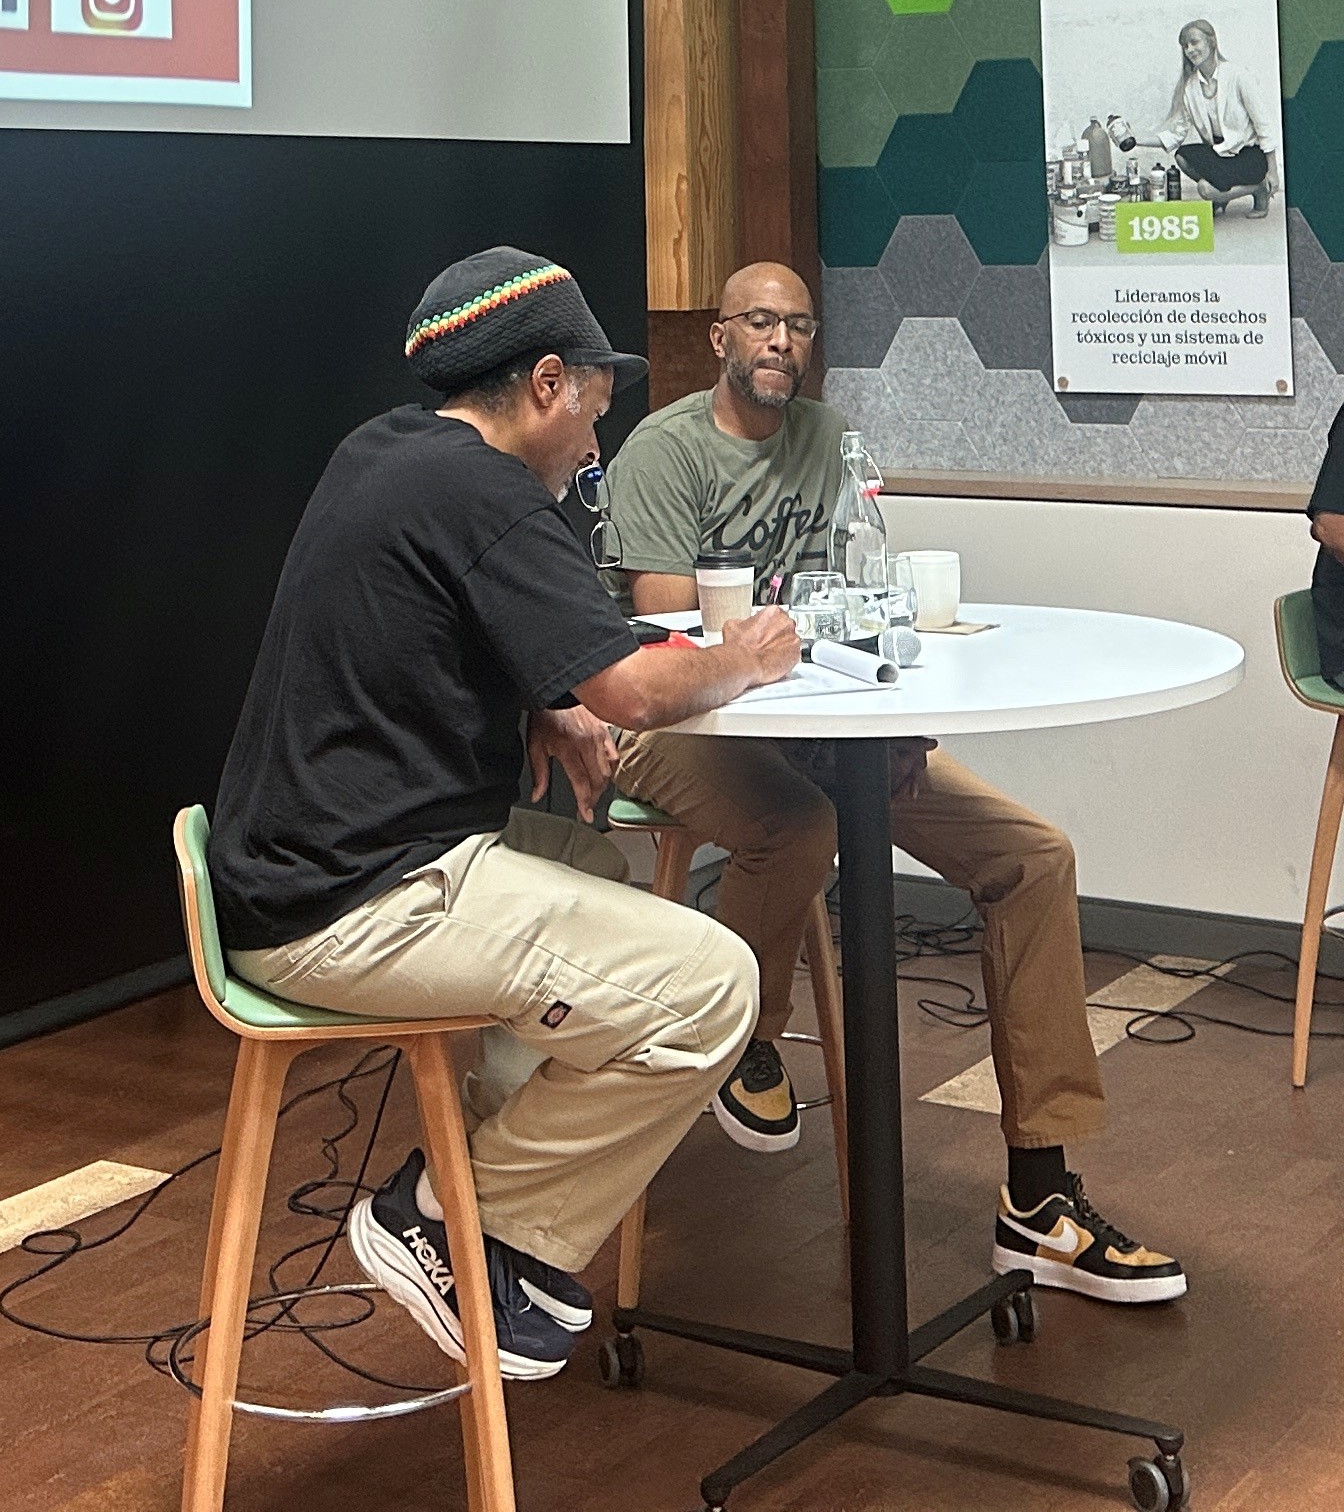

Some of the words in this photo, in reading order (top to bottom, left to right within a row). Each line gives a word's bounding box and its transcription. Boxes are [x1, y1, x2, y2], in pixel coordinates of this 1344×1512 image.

[1128, 215, 1200, 241] 1985
[1114, 289, 1201, 304] Lideramos
[1204, 289, 1220, 303] la
[1071, 309, 1163, 324] recolección
[1167, 310, 1187, 324] de
[1190, 309, 1267, 324] desechos
[1076, 329, 1135, 344] tóxicos
[1138, 333, 1147, 347] y
[1151, 333, 1171, 344] un
[1175, 329, 1240, 345] sistema
[1243, 330, 1264, 345] de
[1112, 350, 1181, 368] reciclaje
[1185, 350, 1228, 366] móvil
[712, 492, 829, 556] Coffee
[402, 1225, 455, 1296] HOKA
